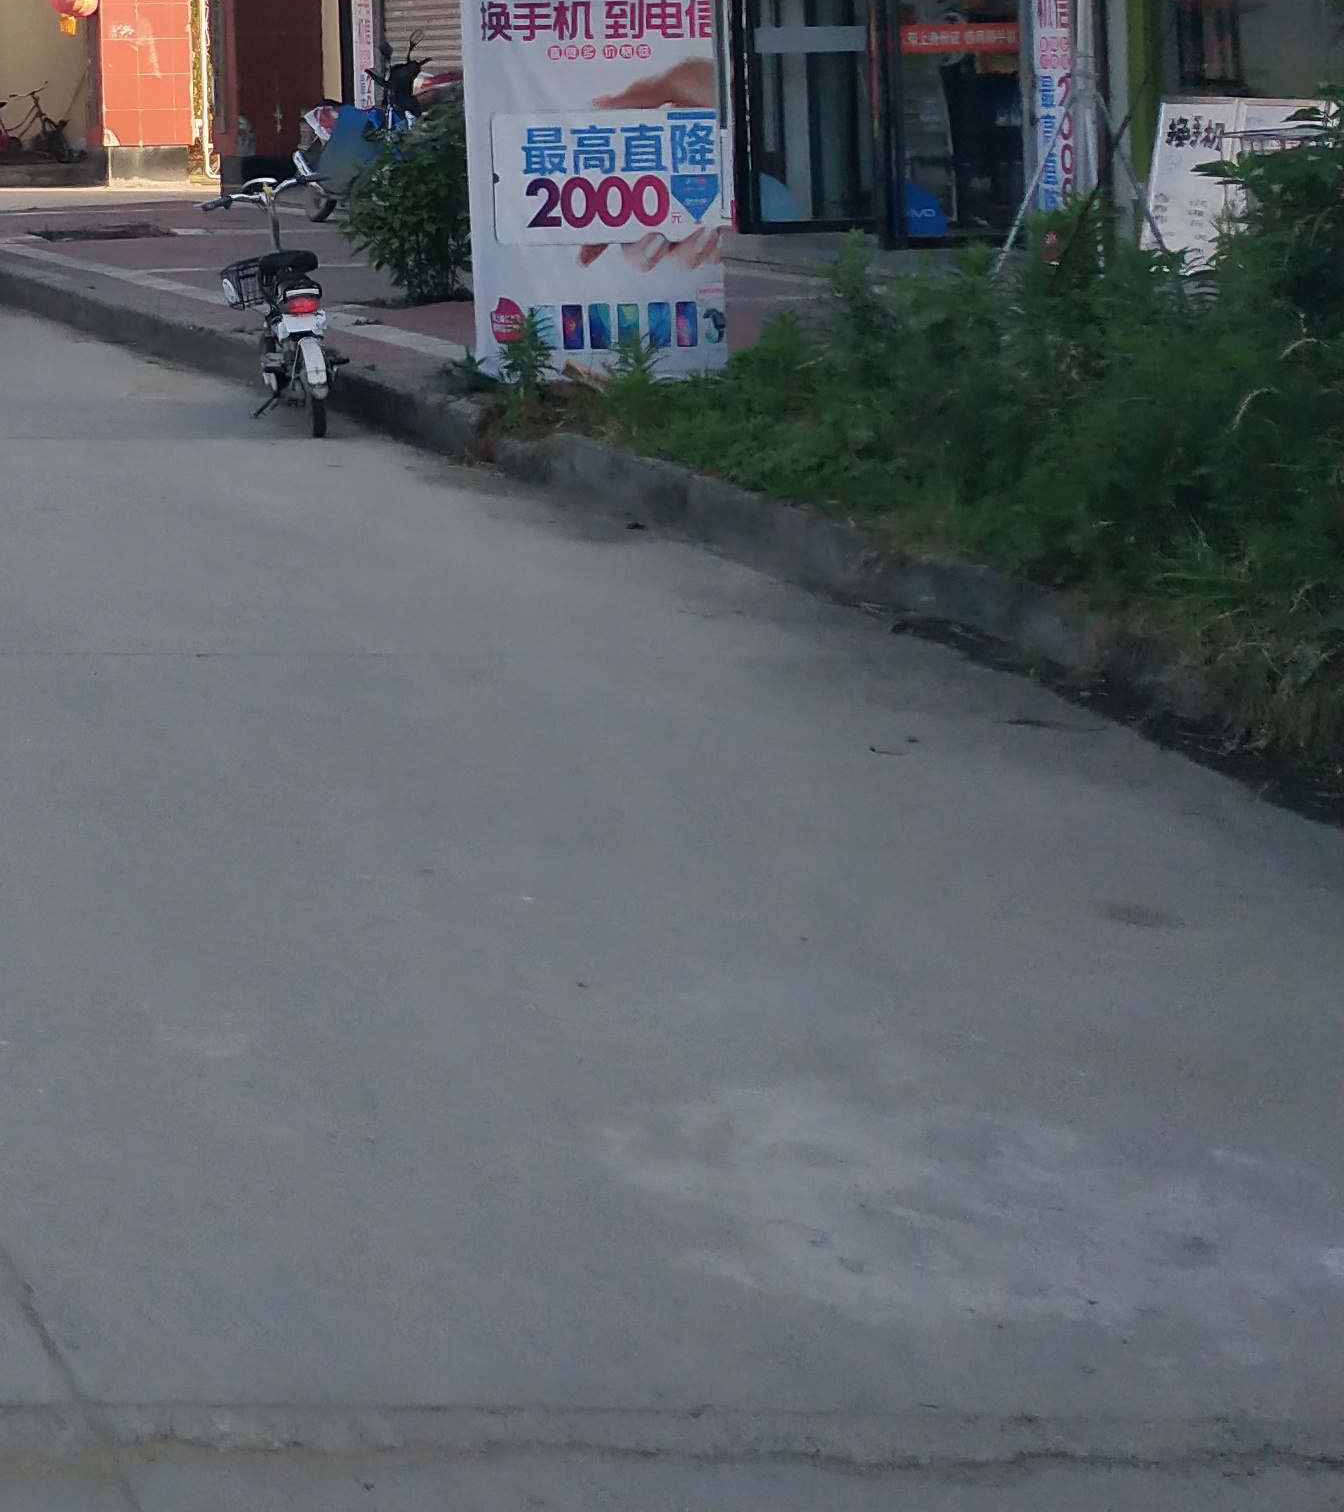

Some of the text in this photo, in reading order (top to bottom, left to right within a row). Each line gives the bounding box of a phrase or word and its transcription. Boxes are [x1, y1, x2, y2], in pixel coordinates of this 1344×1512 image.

[479, 0, 596, 43] 换手机
[521, 121, 716, 176] 最高直降
